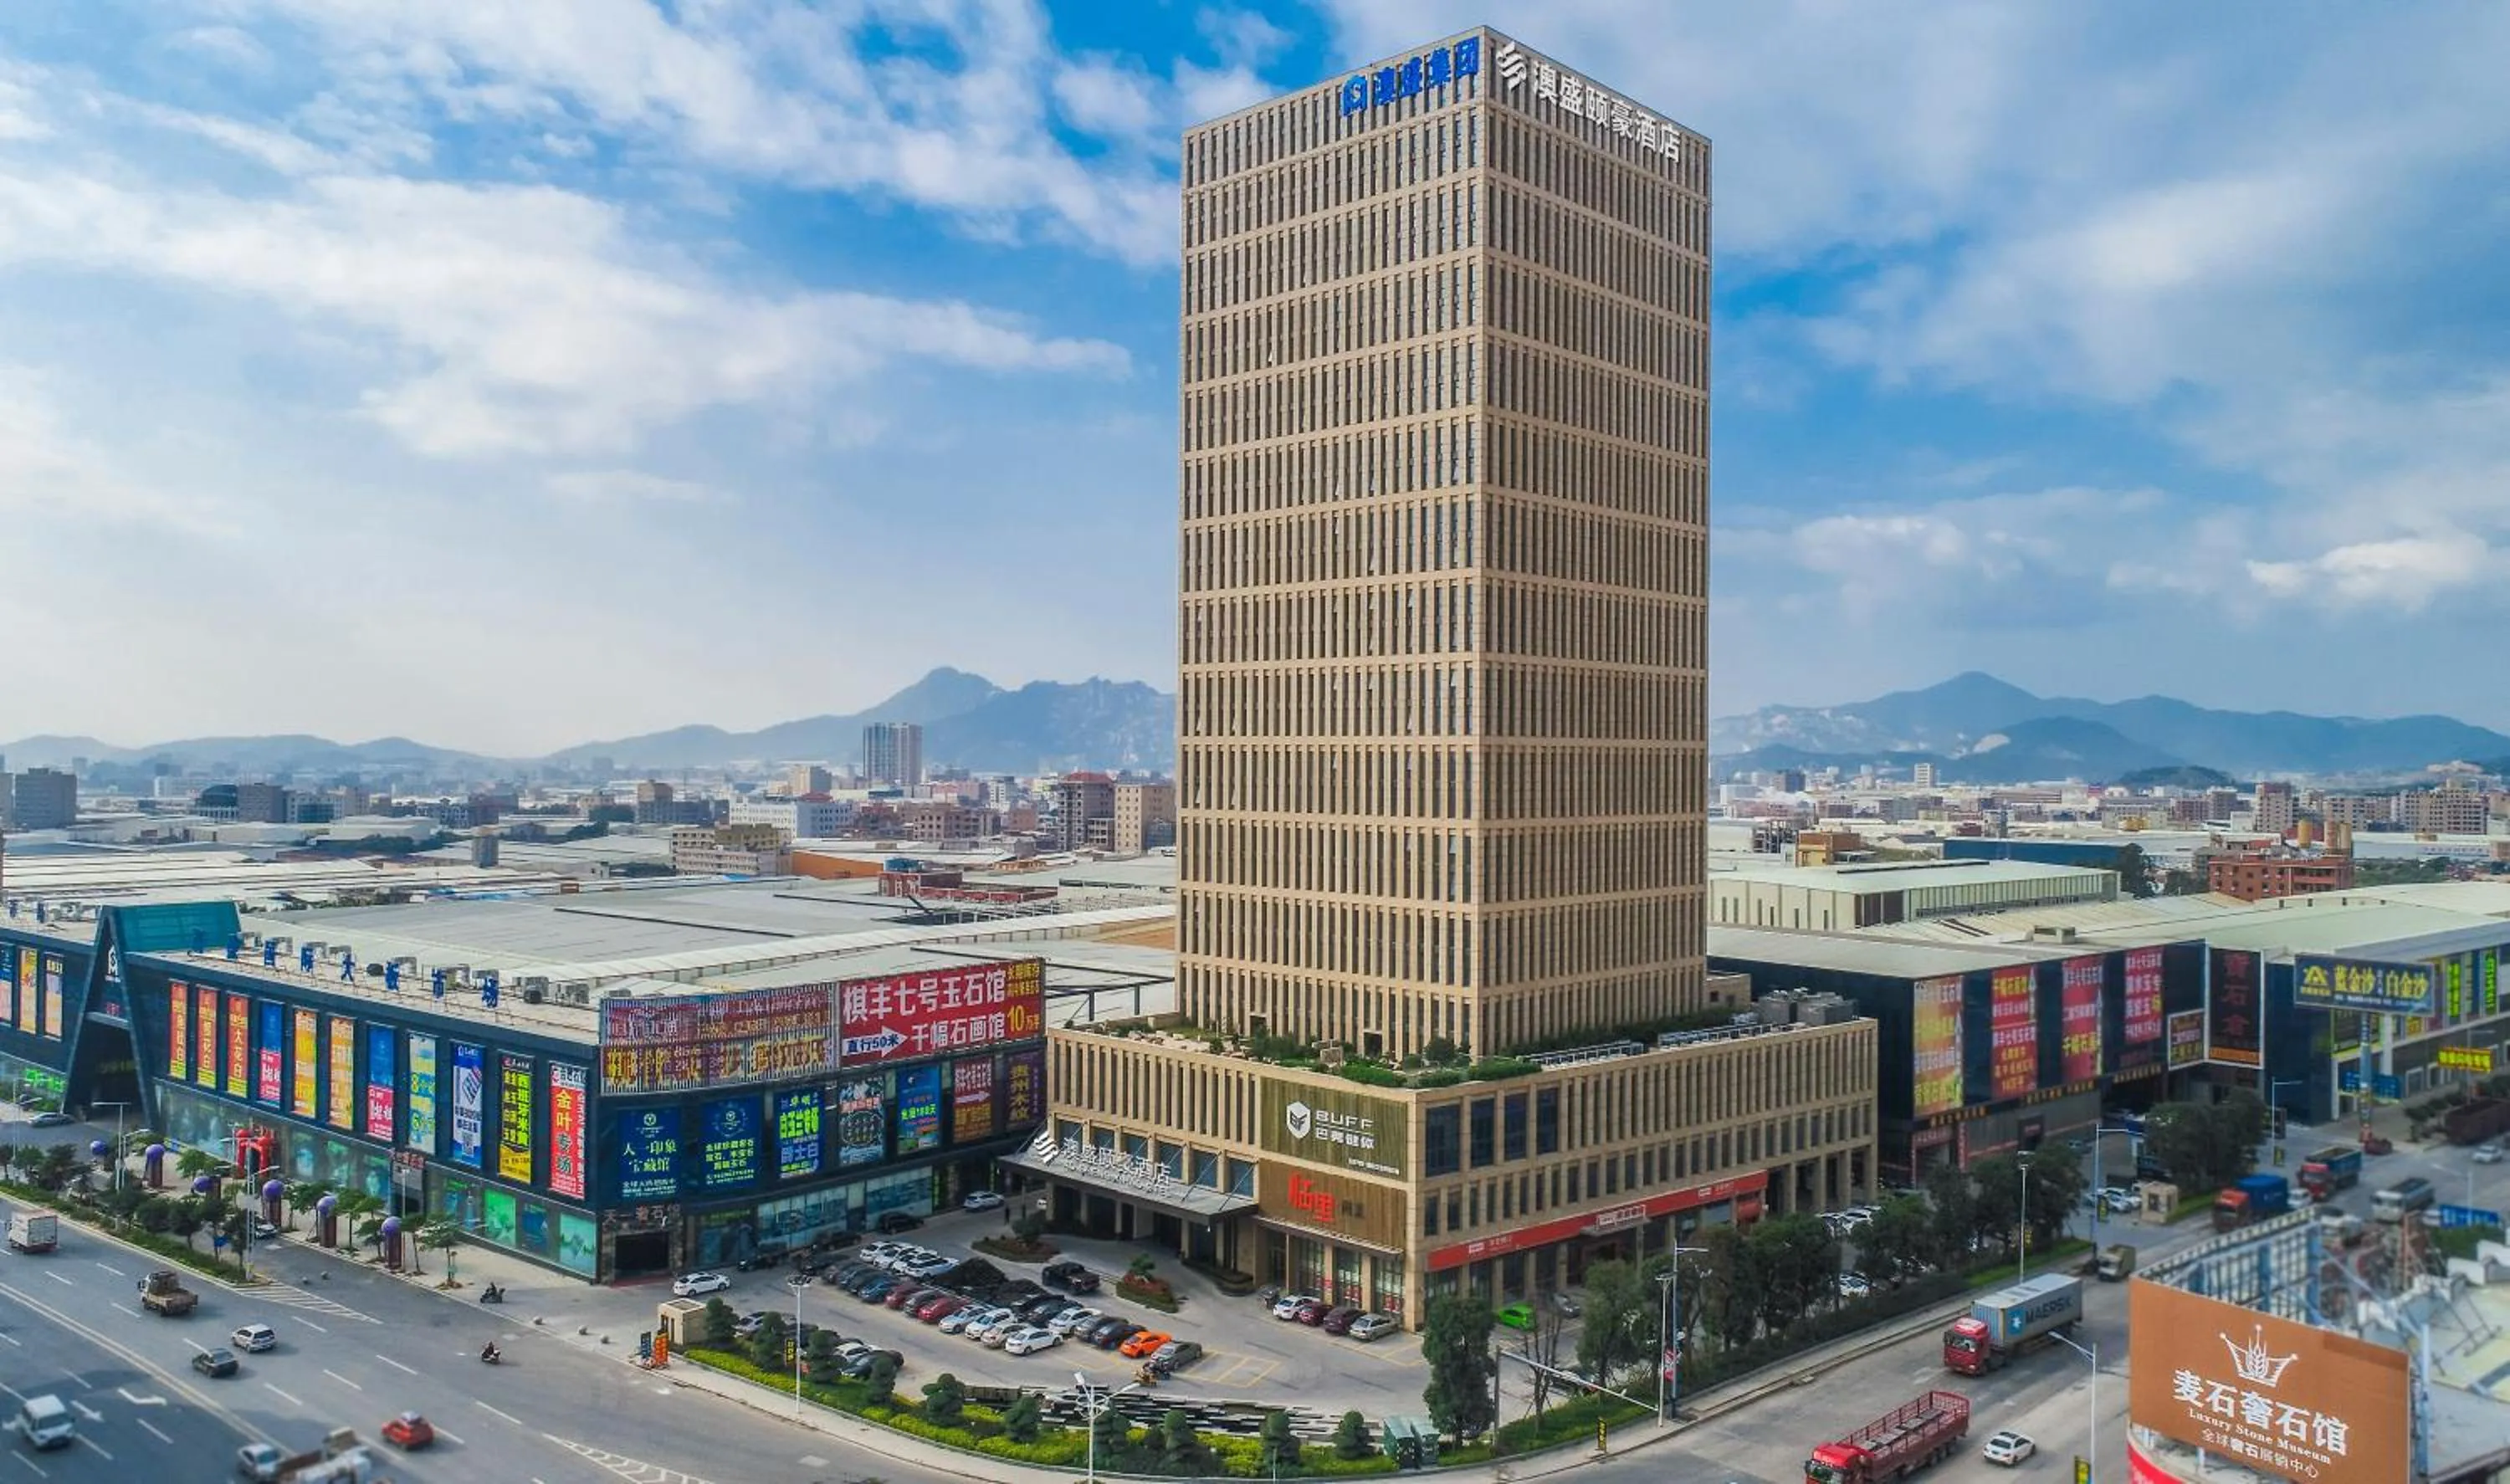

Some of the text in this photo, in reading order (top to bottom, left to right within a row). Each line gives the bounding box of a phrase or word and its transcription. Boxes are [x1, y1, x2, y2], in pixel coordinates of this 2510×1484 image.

[1531, 60, 1681, 163] 澳盛颐豪酒店
[846, 1033, 899, 1053] 直行50米
[1316, 1110, 1374, 1129] BUFF
[2026, 1296, 2073, 1323] MAERSK
[2172, 1369, 2349, 1456] 麦石奢石馆
[2189, 1409, 2332, 1465] Luxury Stone Museum
